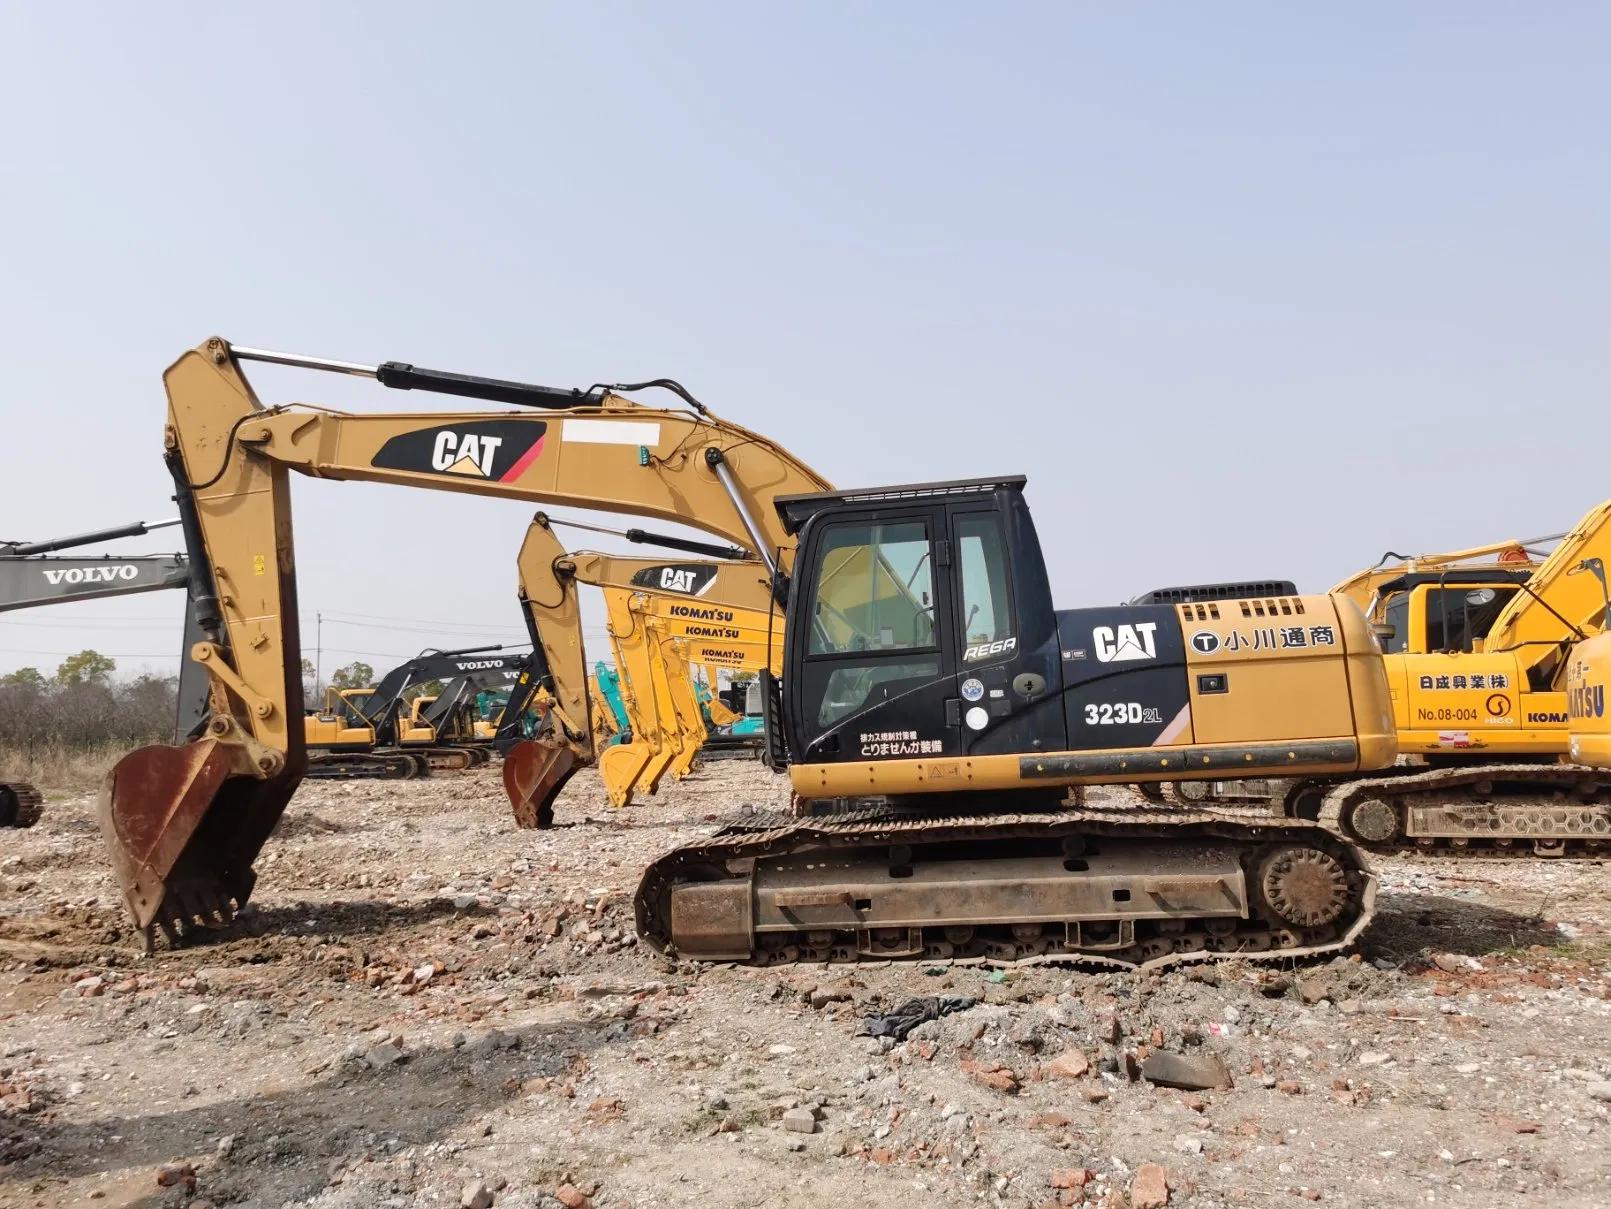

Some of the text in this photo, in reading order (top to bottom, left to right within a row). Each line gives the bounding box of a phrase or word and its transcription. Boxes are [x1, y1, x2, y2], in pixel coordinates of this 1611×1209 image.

[432, 430, 503, 477] CAT
[42, 564, 139, 585] VOLVO
[660, 567, 697, 593] CAT
[670, 605, 734, 622] KOMATSU
[685, 626, 740, 639] KOMATSU
[1224, 626, 1335, 651] 小川通商
[963, 637, 1017, 661] REGA
[1092, 622, 1157, 663] CAT
[701, 648, 745, 660] KOMATSU
[456, 660, 504, 671] VOLVO
[1419, 674, 1509, 690] 日成興業(株)
[1418, 708, 1478, 721] No.08-004
[1527, 712, 1569, 723] KOMA
